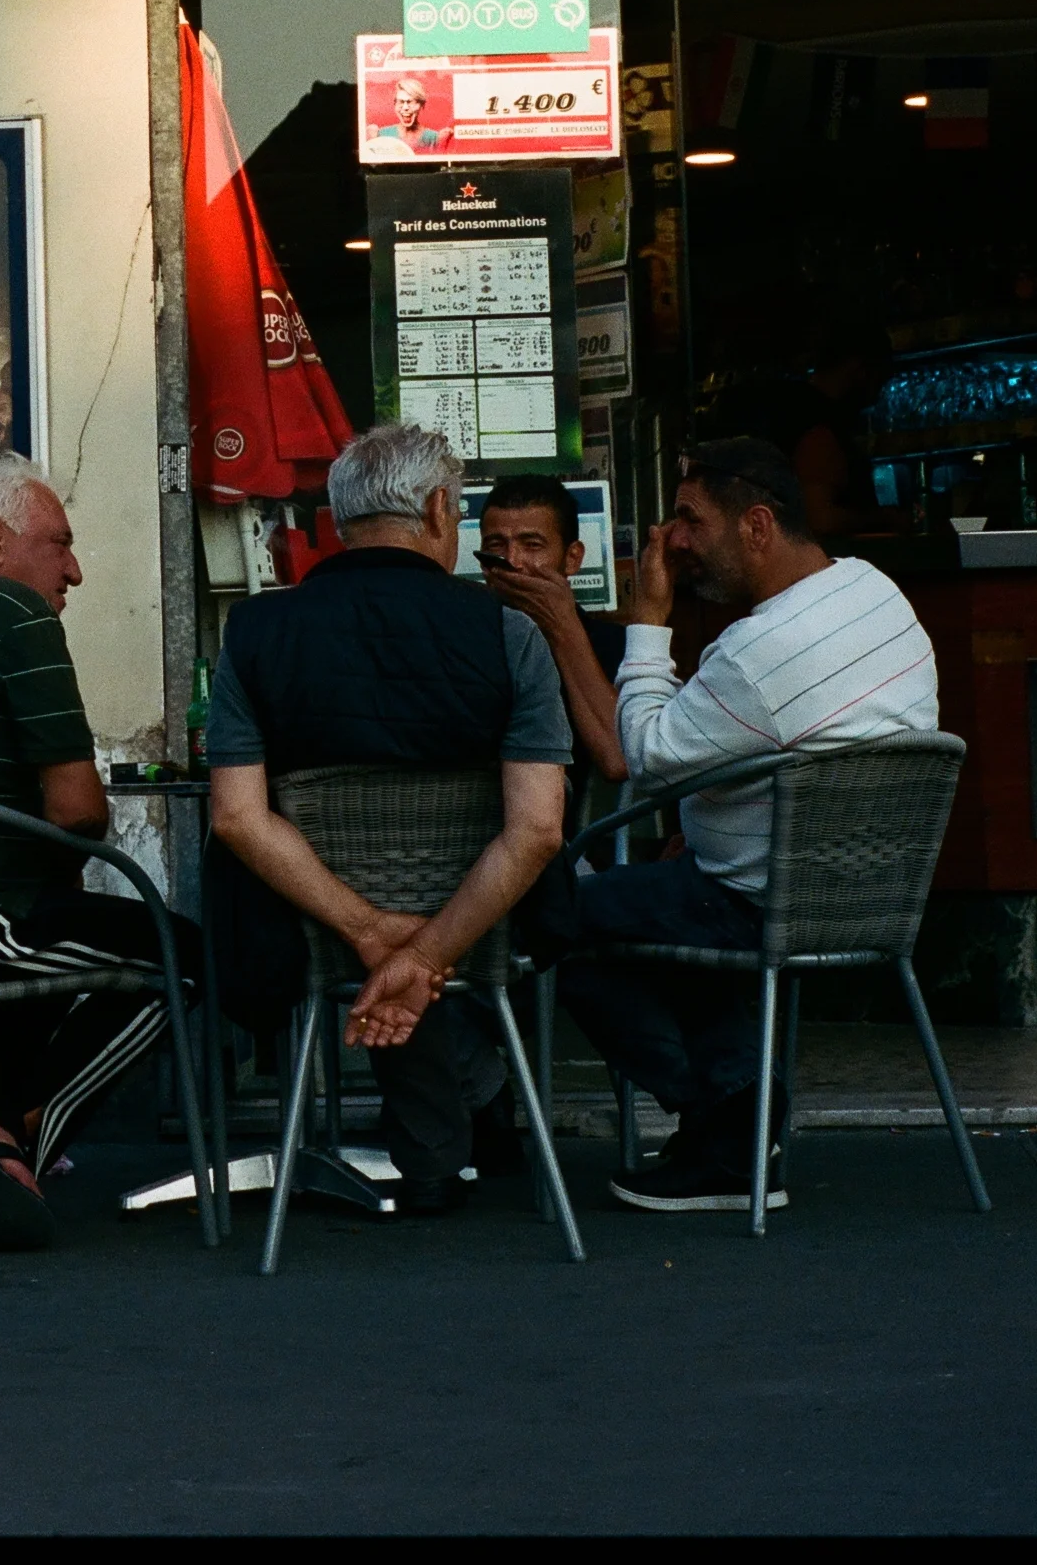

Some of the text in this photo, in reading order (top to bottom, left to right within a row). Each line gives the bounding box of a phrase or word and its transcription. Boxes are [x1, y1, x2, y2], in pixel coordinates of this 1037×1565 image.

[447, 8, 464, 24] M
[481, 7, 496, 23] T
[511, 7, 533, 20] BUS
[592, 79, 603, 95] €
[485, 93, 577, 114] 1.400
[442, 199, 496, 211] Heineken
[394, 216, 547, 233] Tarif des Consommations
[218, 443, 238, 453] BOCK
[219, 436, 240, 447] SUPER
